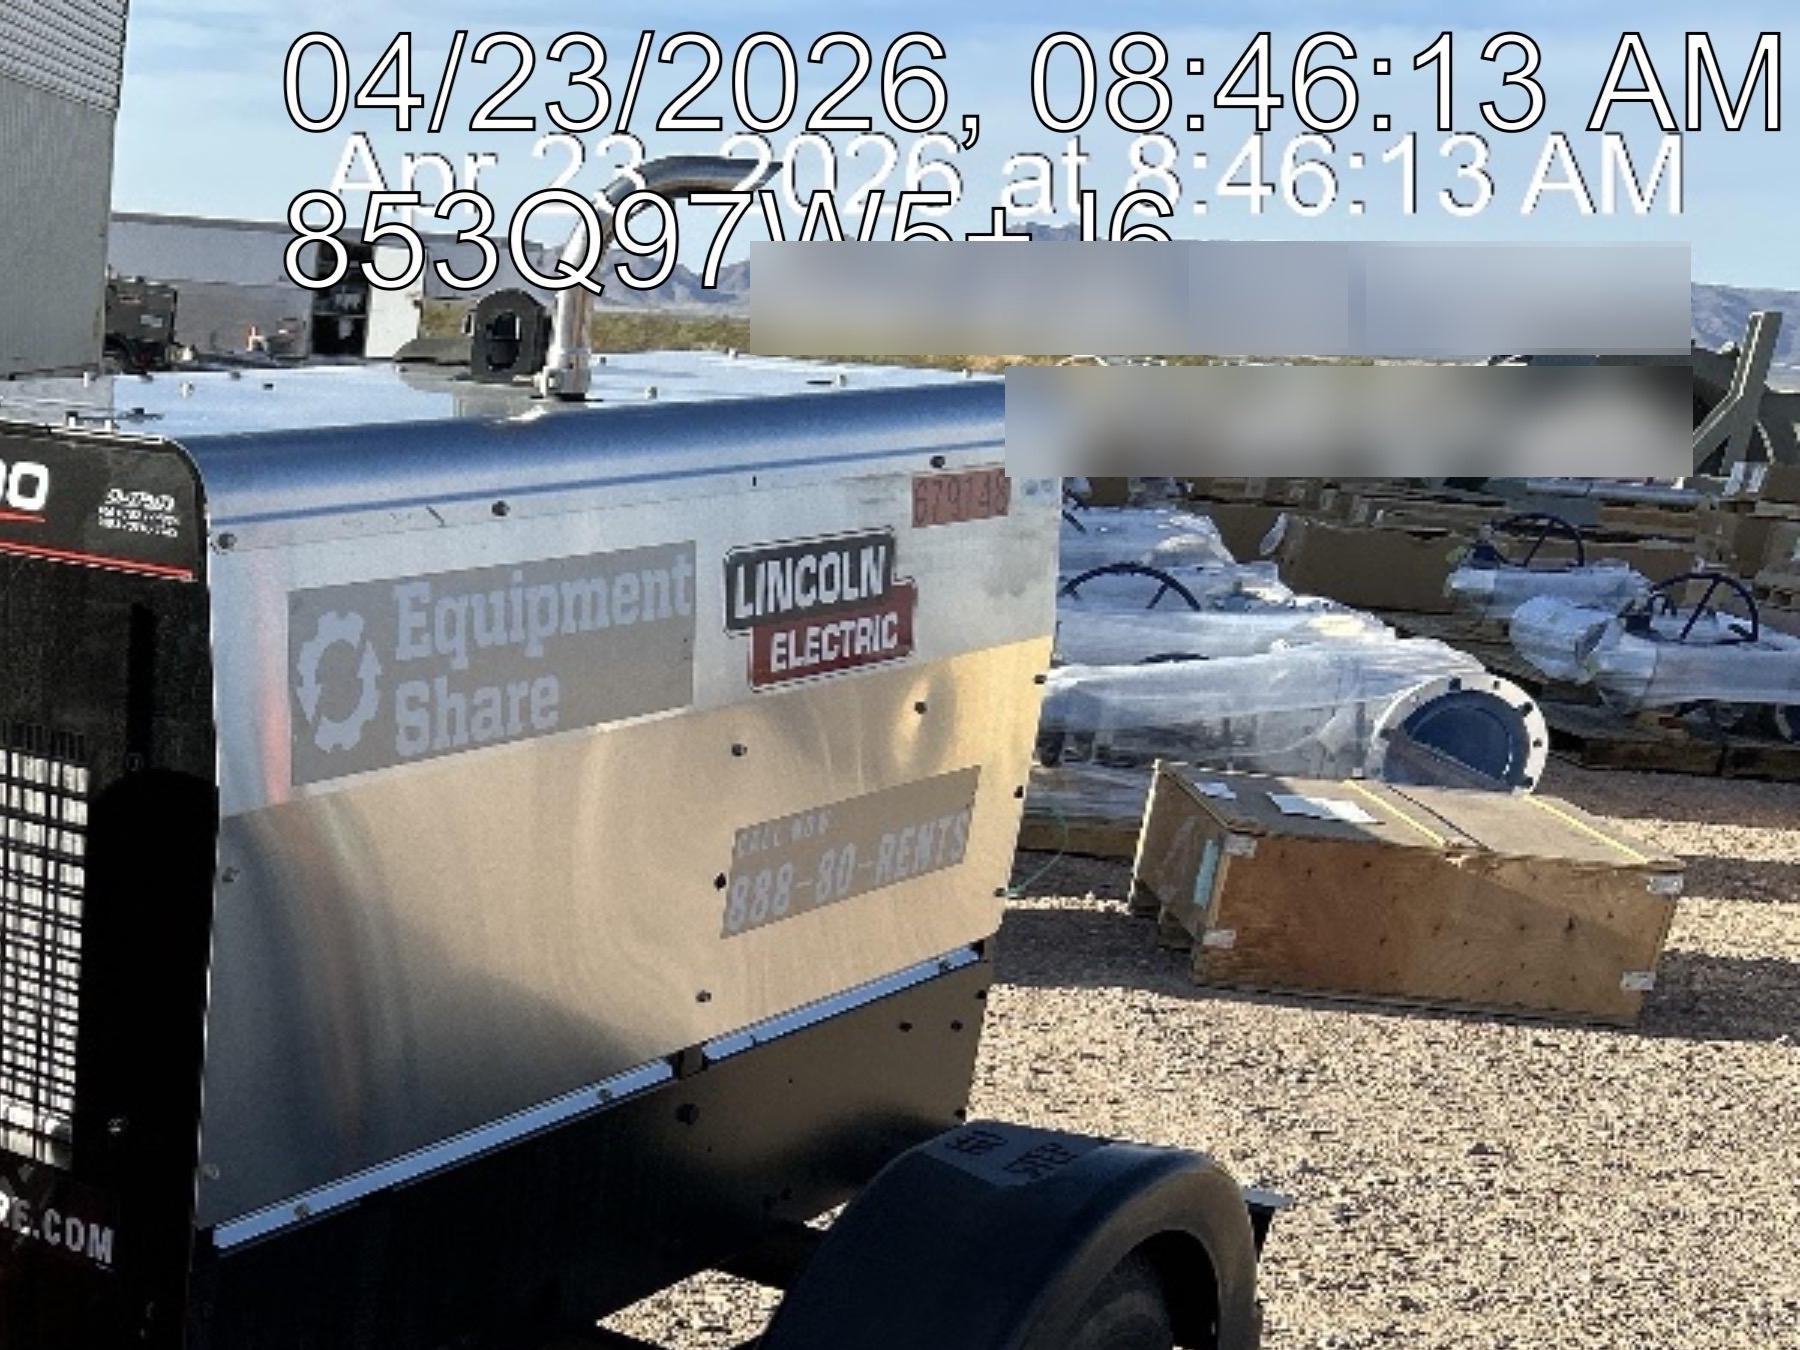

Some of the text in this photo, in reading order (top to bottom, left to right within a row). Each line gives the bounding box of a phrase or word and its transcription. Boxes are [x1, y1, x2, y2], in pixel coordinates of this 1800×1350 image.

[392, 552, 694, 670] Equipment
[734, 545, 887, 619] LINCOLN
[770, 611, 899, 673] ELECTRIC
[394, 671, 560, 757] Share
